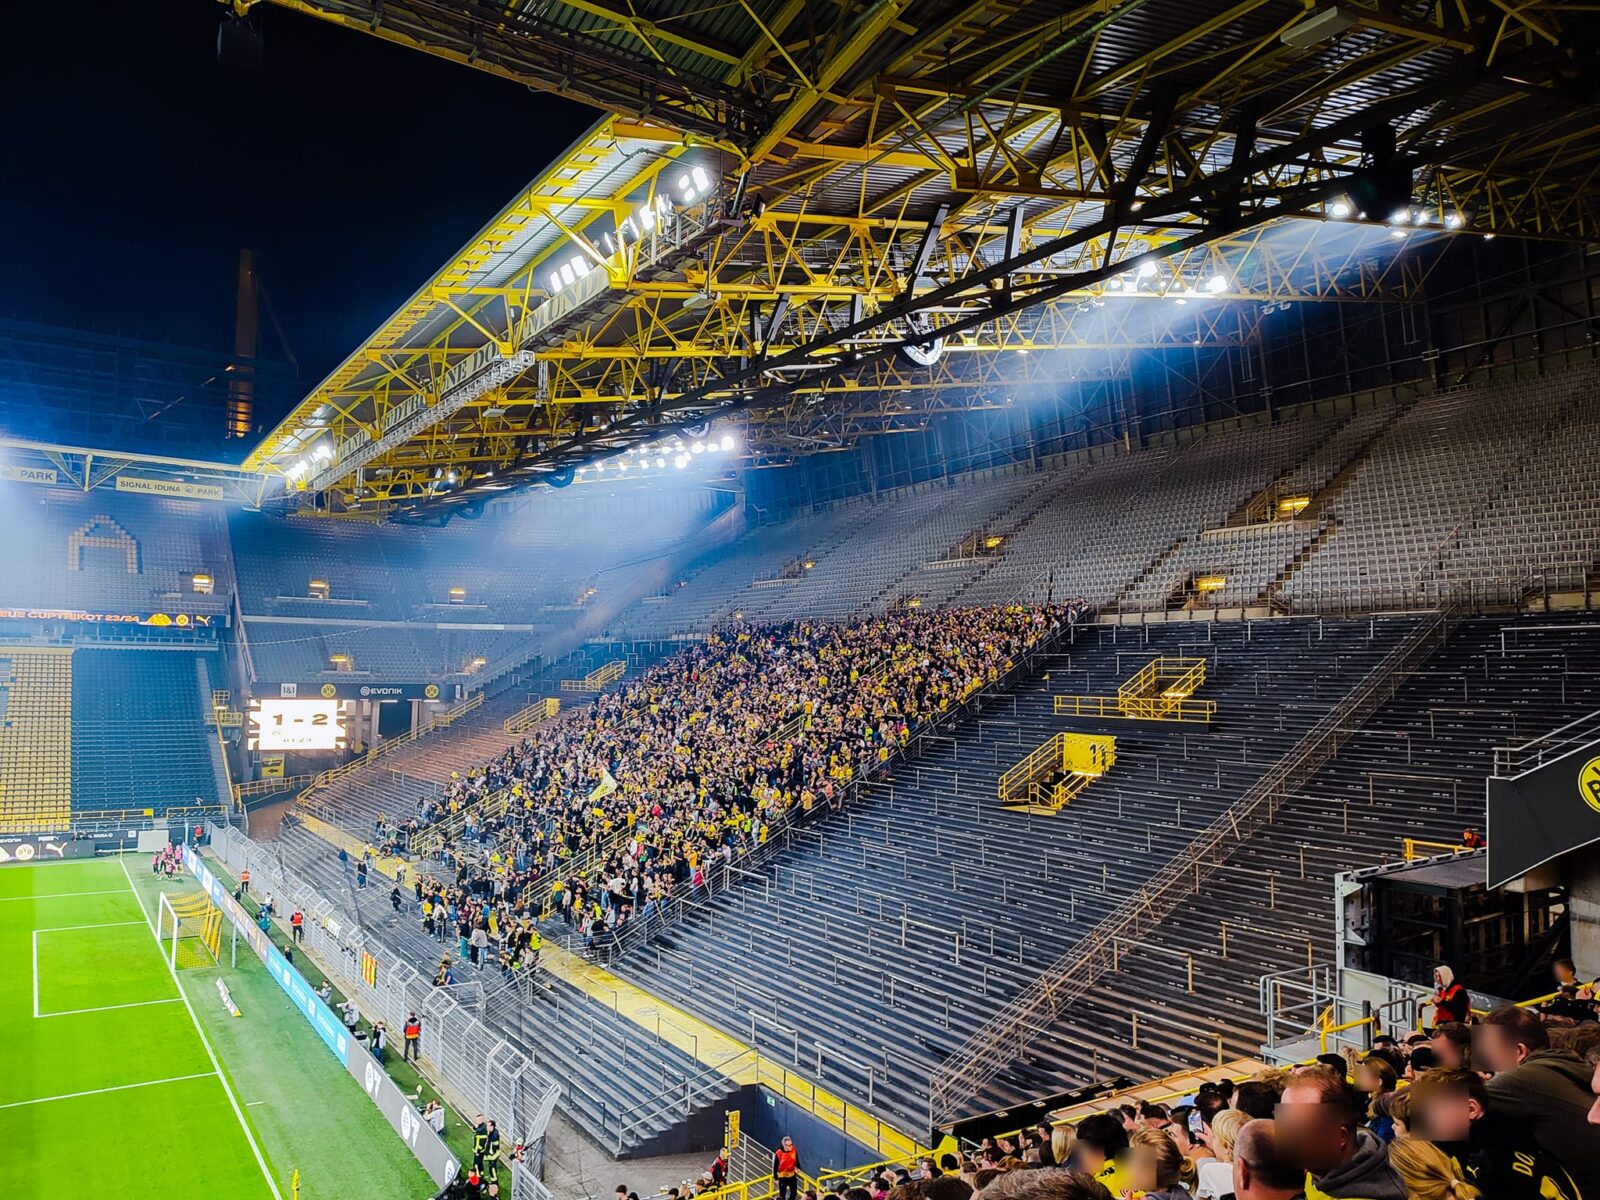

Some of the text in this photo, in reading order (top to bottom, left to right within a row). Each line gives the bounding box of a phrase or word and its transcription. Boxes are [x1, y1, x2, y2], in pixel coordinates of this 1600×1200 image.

[20, 470, 53, 481] PARK
[120, 480, 220, 497] SIGNAL IDUNA PARK
[282, 686, 295, 694] 1&1
[273, 714, 283, 726] 1
[311, 713, 328, 726] 2
